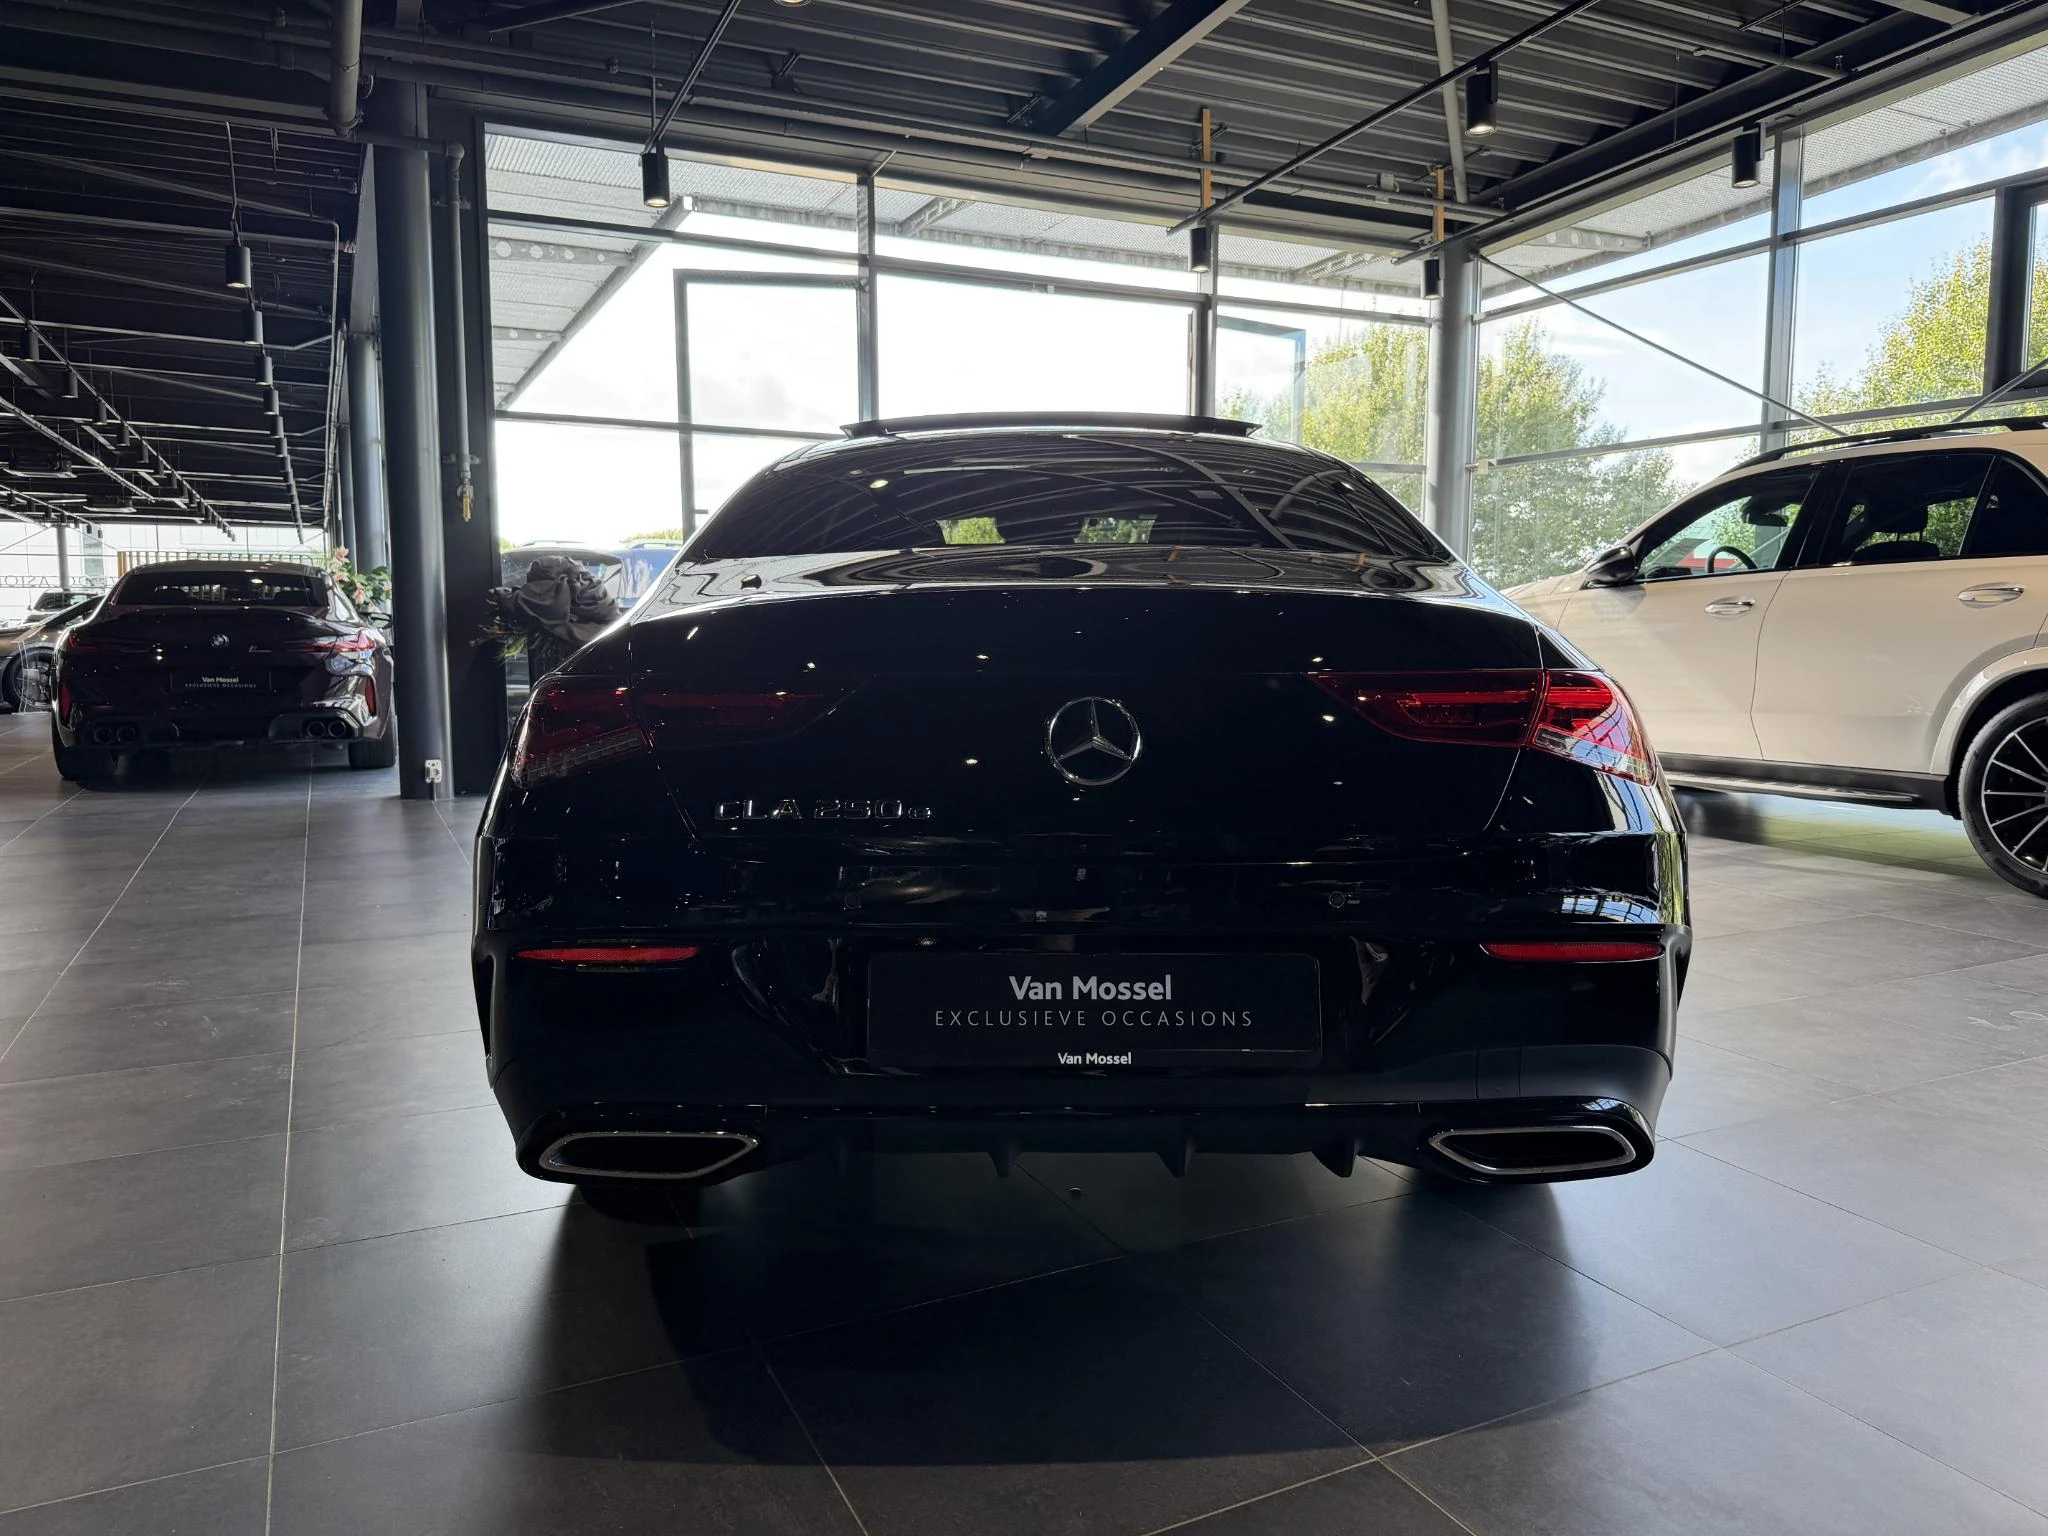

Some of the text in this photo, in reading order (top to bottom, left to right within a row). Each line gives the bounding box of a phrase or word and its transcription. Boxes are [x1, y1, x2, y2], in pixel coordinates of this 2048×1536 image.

[715, 799, 933, 820] CLA 250e
[1008, 974, 1172, 1001] Van Mossel
[935, 1010, 1253, 1027] EXCLUSIEVE OCCASIONS
[1057, 1052, 1132, 1065] Van Mossel
